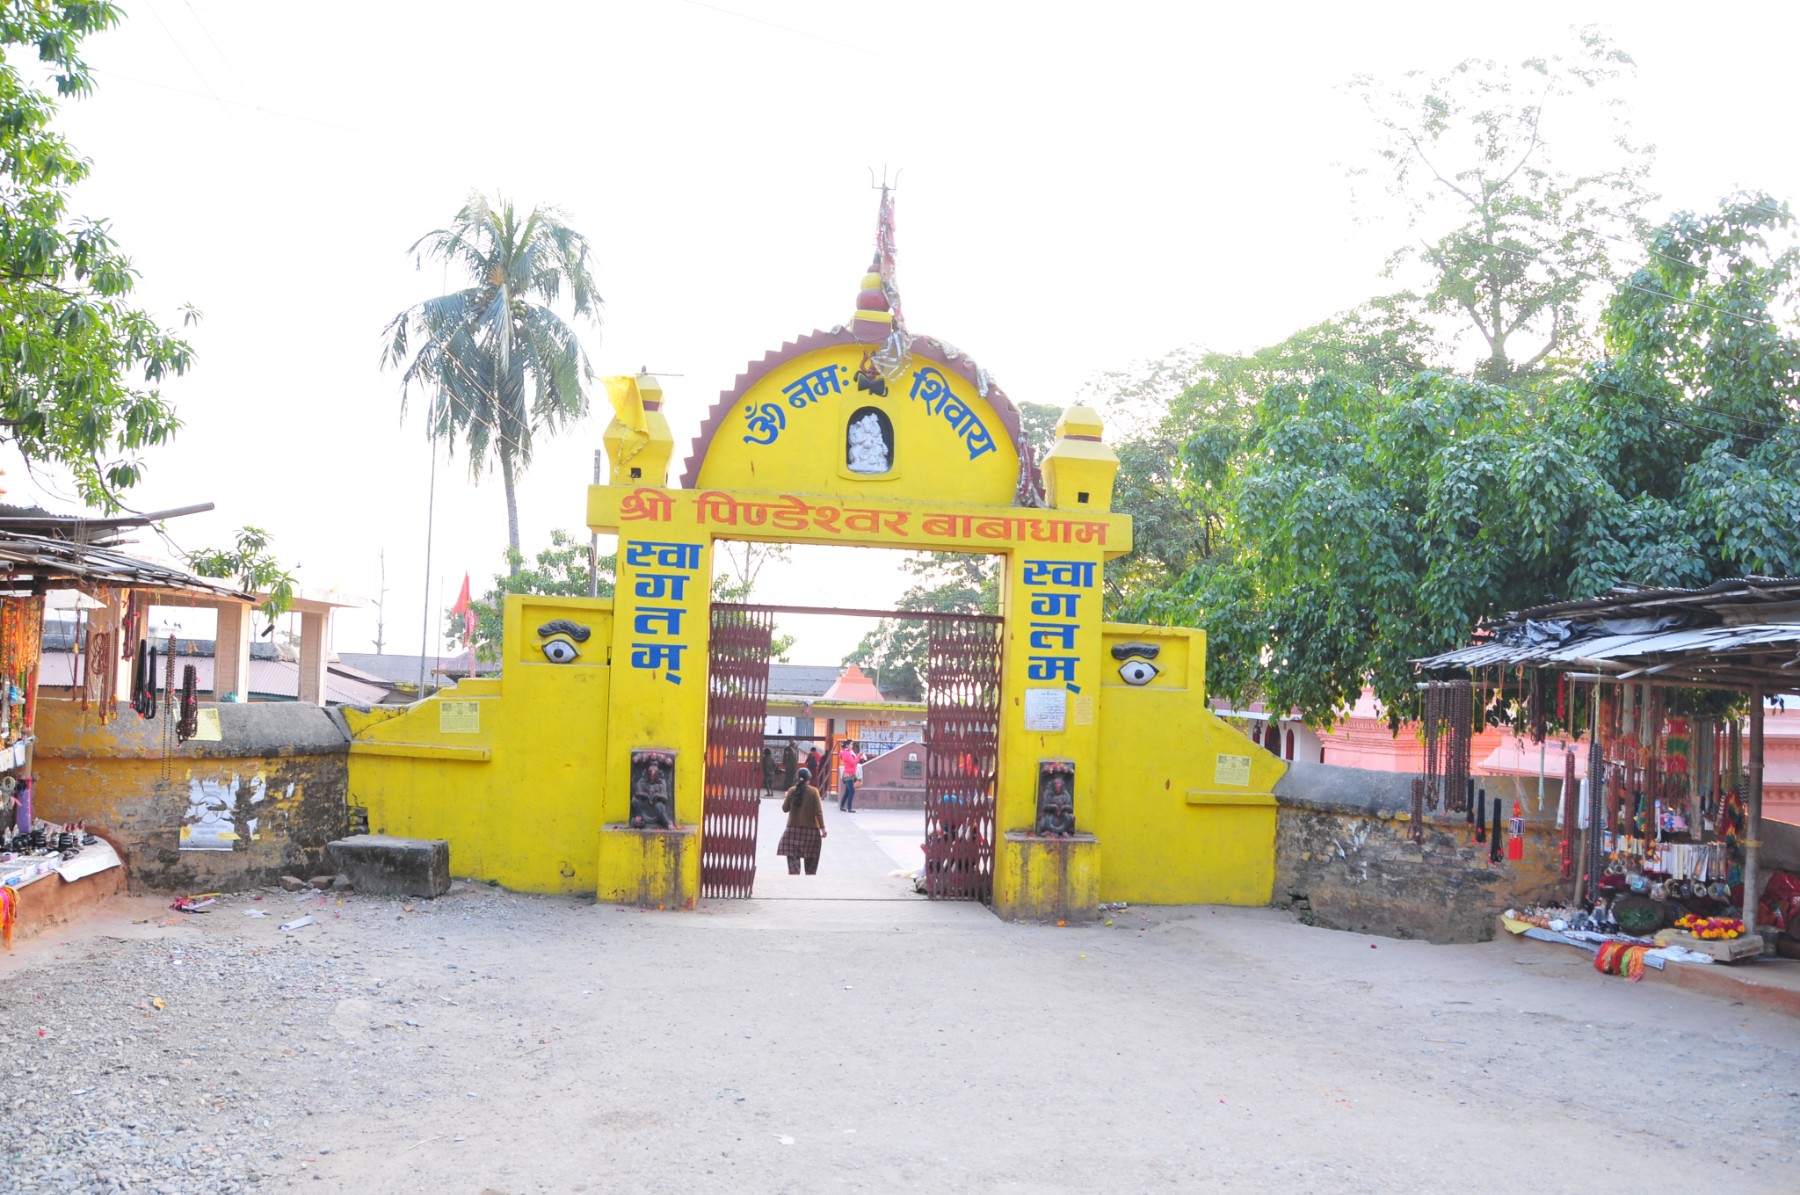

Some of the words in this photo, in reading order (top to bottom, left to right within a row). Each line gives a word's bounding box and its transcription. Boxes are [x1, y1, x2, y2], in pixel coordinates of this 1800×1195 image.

[909, 367, 997, 461] शिवाय
[620, 488, 676, 522] श्री
[922, 513, 1110, 545] बाबाधाम
